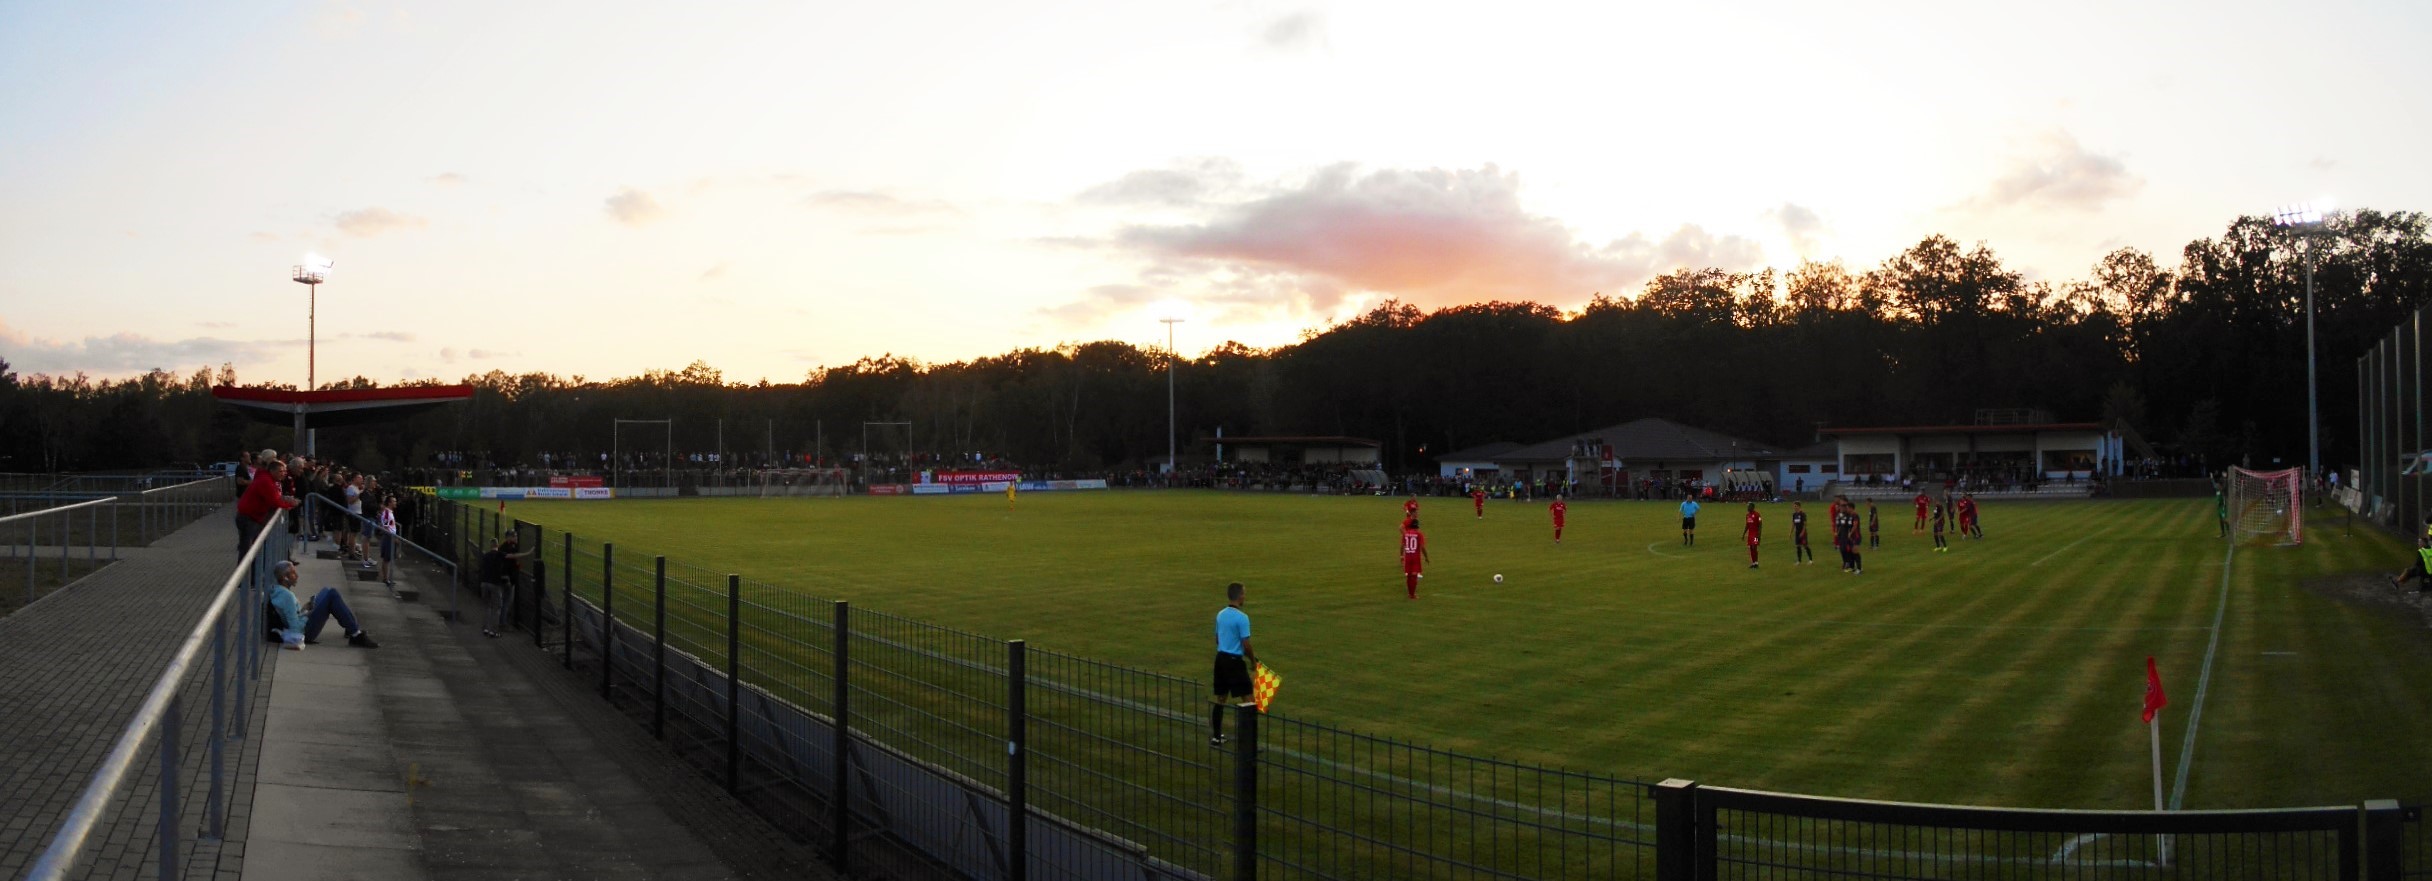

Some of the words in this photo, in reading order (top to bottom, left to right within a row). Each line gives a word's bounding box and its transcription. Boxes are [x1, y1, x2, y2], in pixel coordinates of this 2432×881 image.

[938, 474, 953, 482] FSV
[954, 474, 977, 482] OPTIK
[978, 473, 1018, 481] RATHENOW
[1405, 537, 1417, 550] 10
